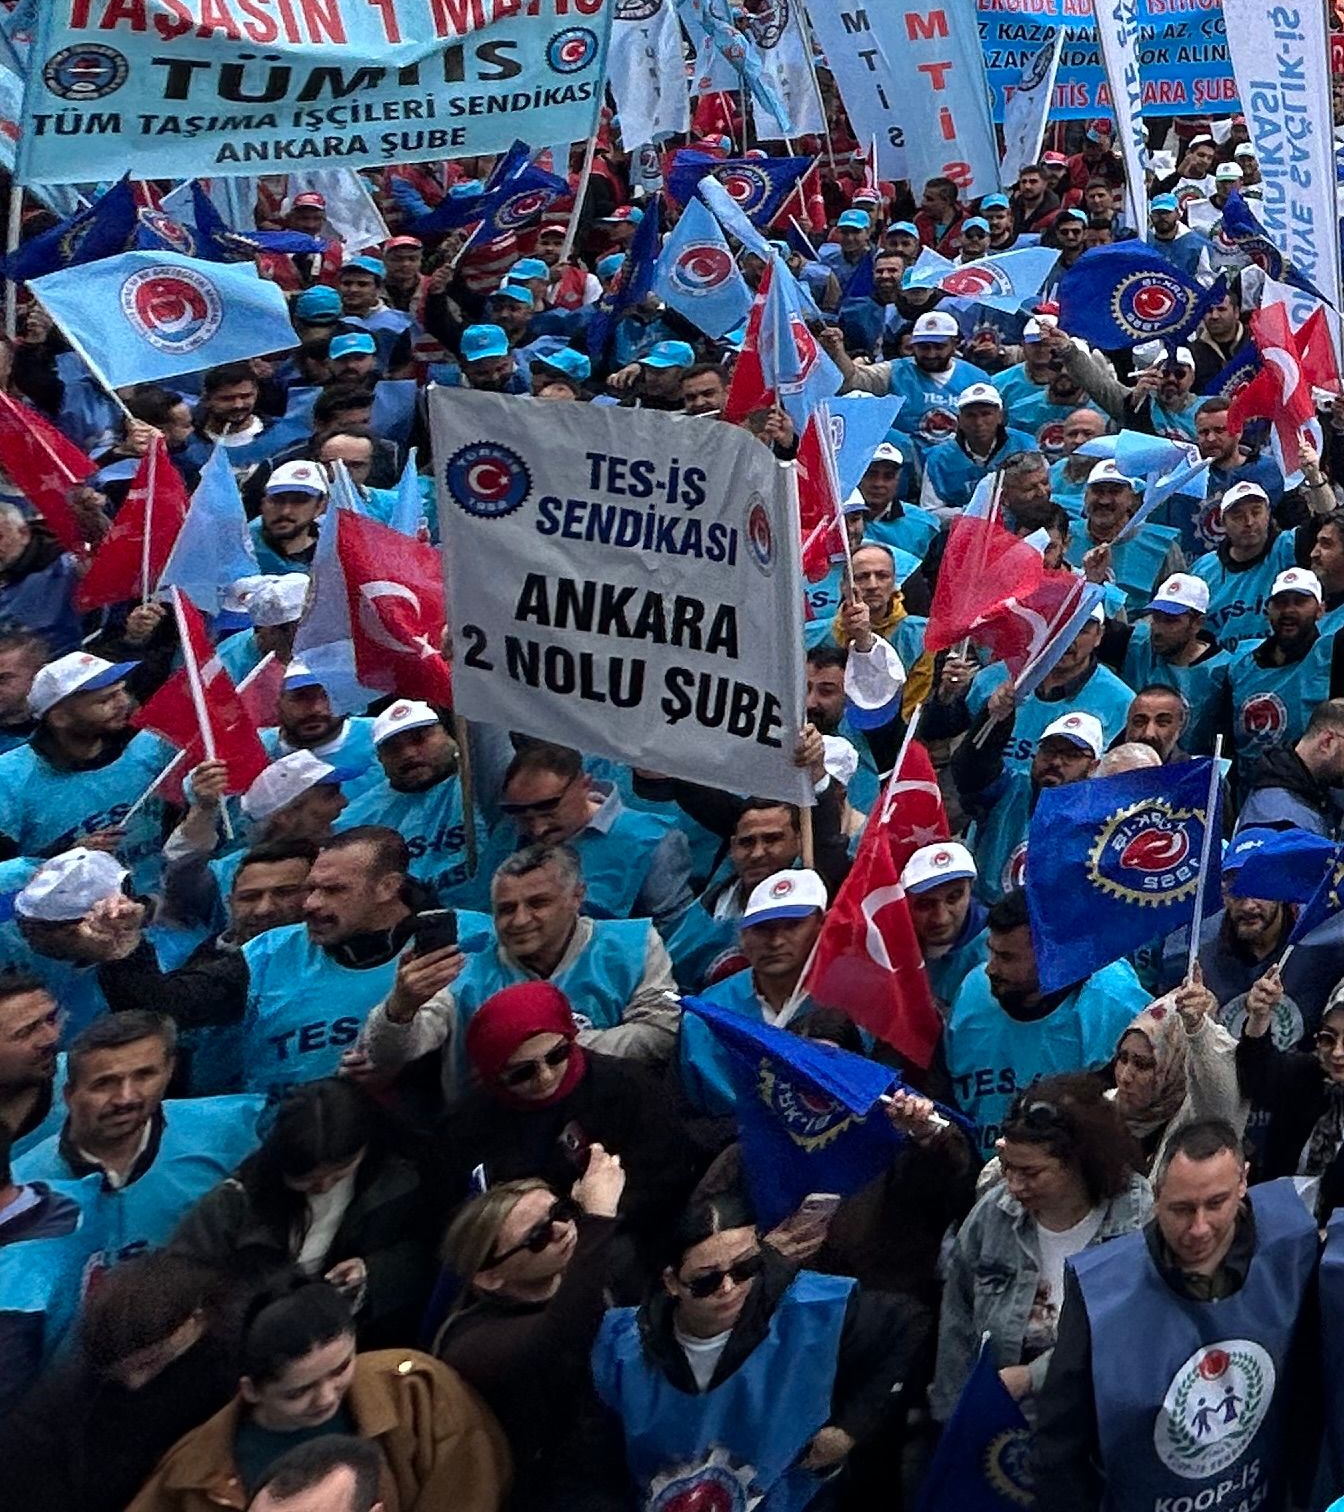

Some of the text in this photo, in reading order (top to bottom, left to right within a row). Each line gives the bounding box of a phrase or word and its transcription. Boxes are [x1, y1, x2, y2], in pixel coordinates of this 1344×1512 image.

[32, 80, 603, 138] TÜM TAŞIMA İŞÇİLERİ SENDİKASI
[215, 126, 467, 165] ANKARA ŞUBE
[585, 451, 707, 510] TES-İŞ
[535, 496, 738, 566] SENDİKASI
[515, 573, 740, 659] ANKARA
[462, 624, 783, 748] 2 NOLU ŞUBE
